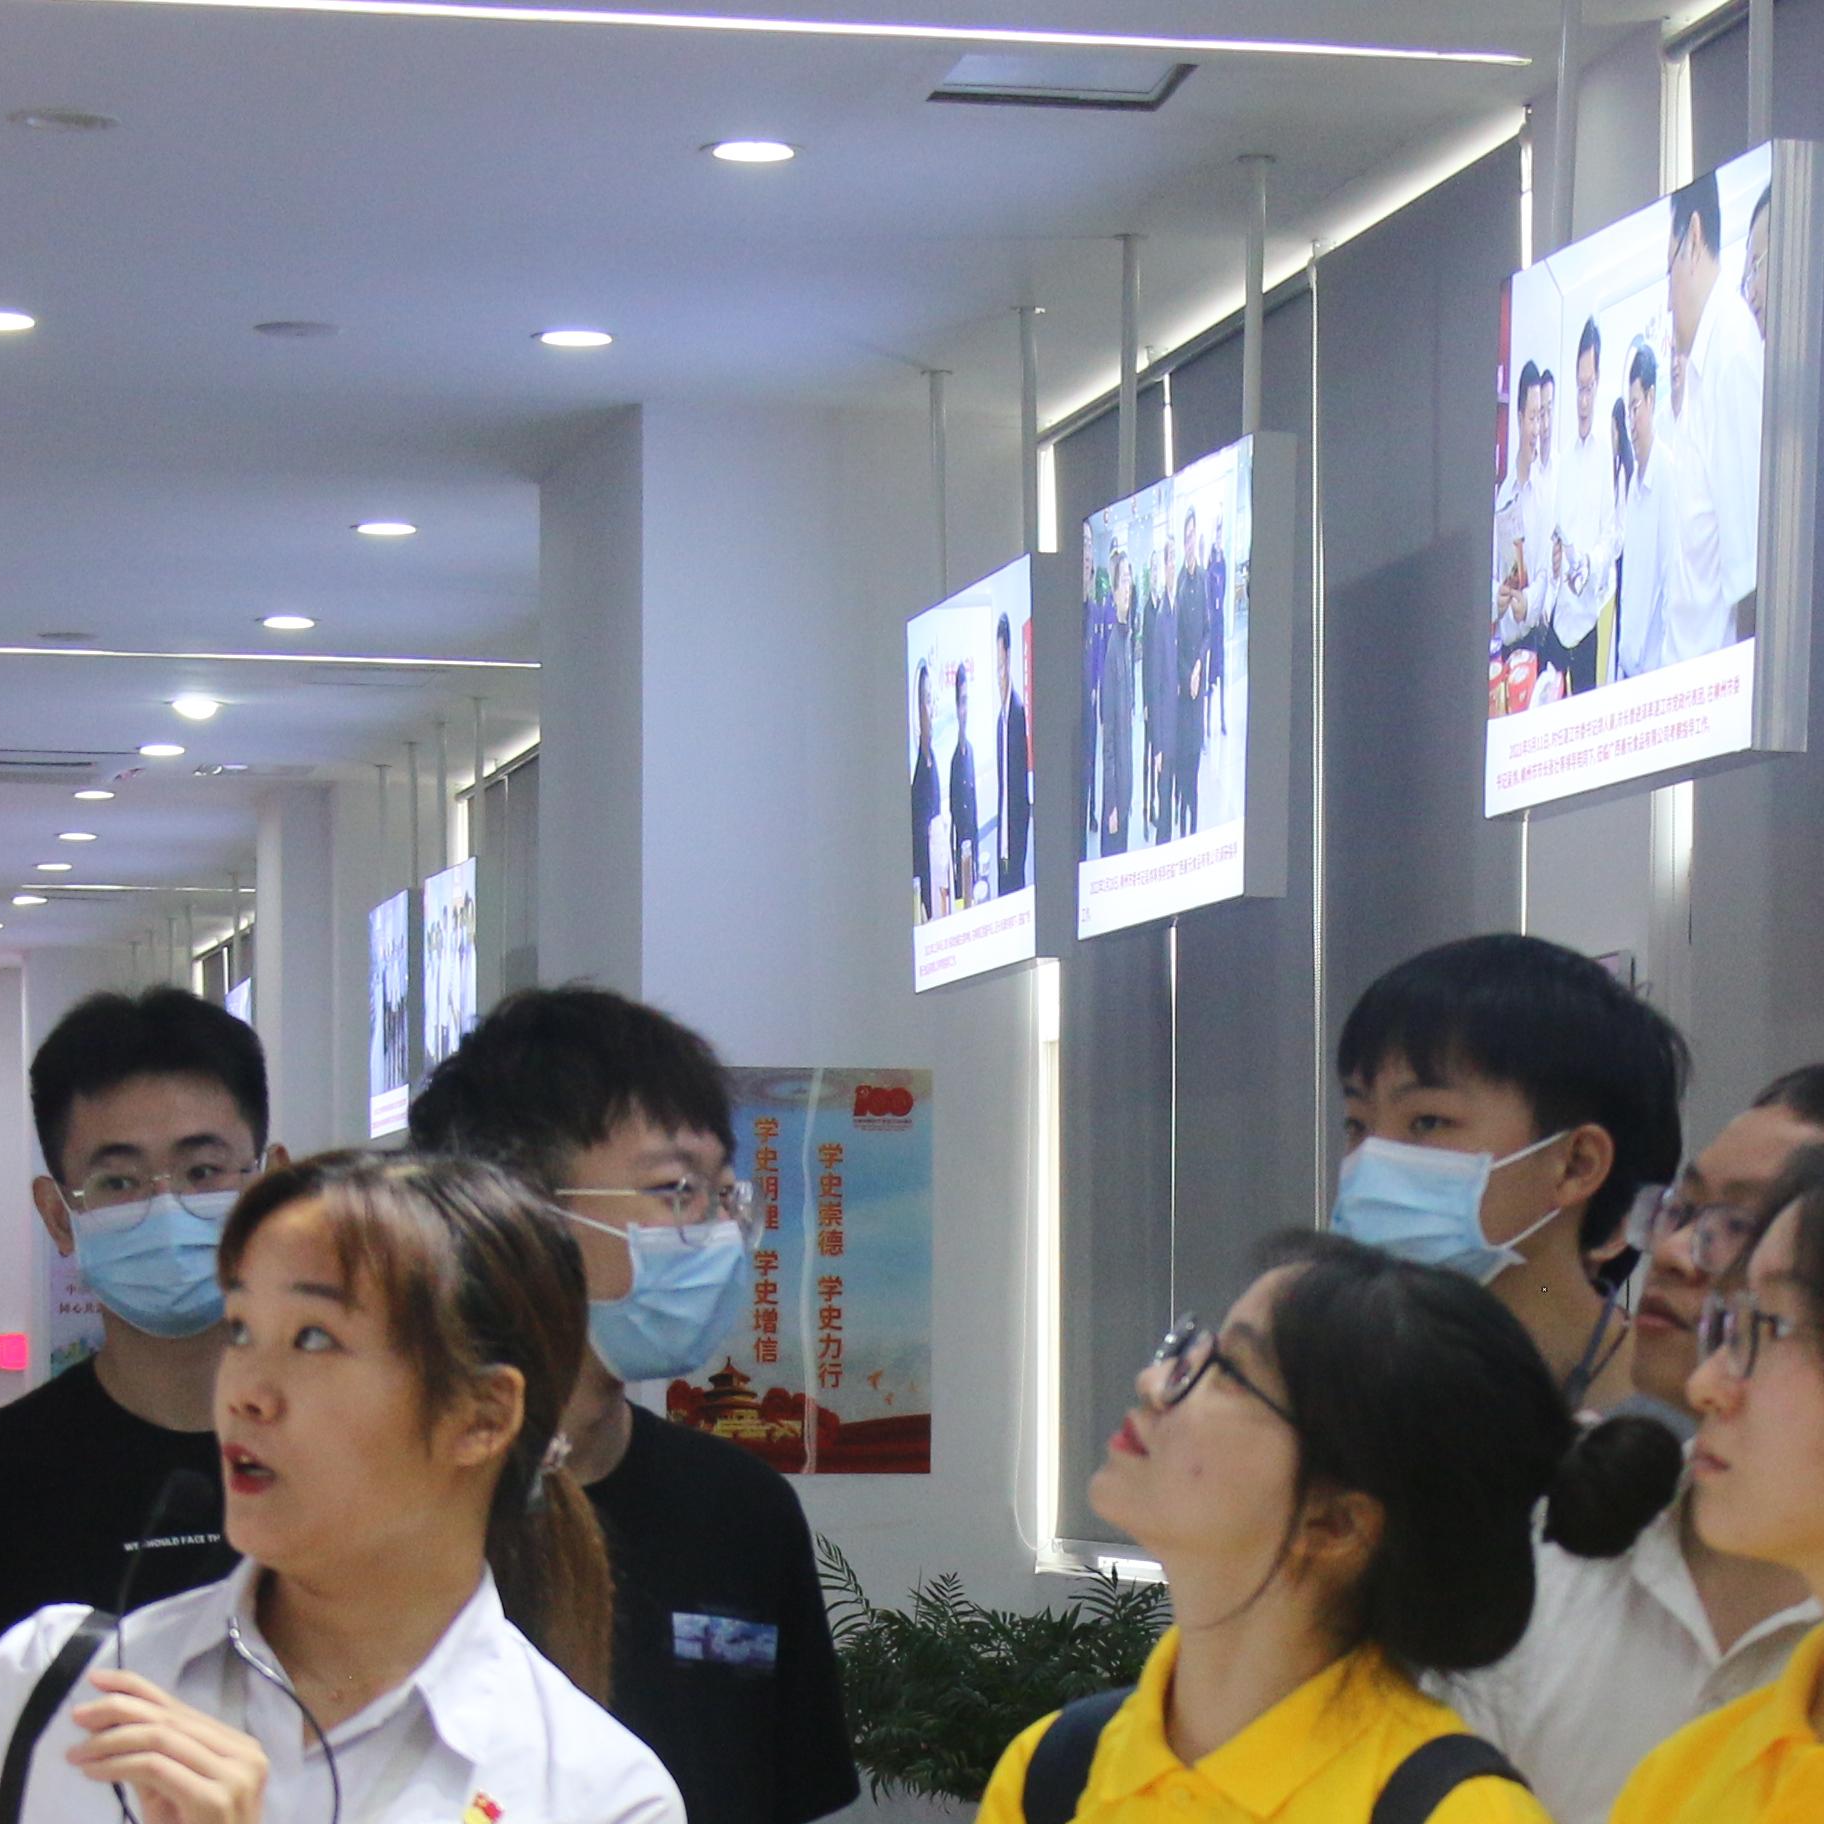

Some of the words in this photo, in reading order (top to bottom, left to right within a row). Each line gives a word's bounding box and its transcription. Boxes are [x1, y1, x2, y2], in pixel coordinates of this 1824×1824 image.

[817, 1142, 844, 1257] 学史崇德
[752, 1249, 779, 1364] 学史增信
[817, 1275, 844, 1390] 学史力行
